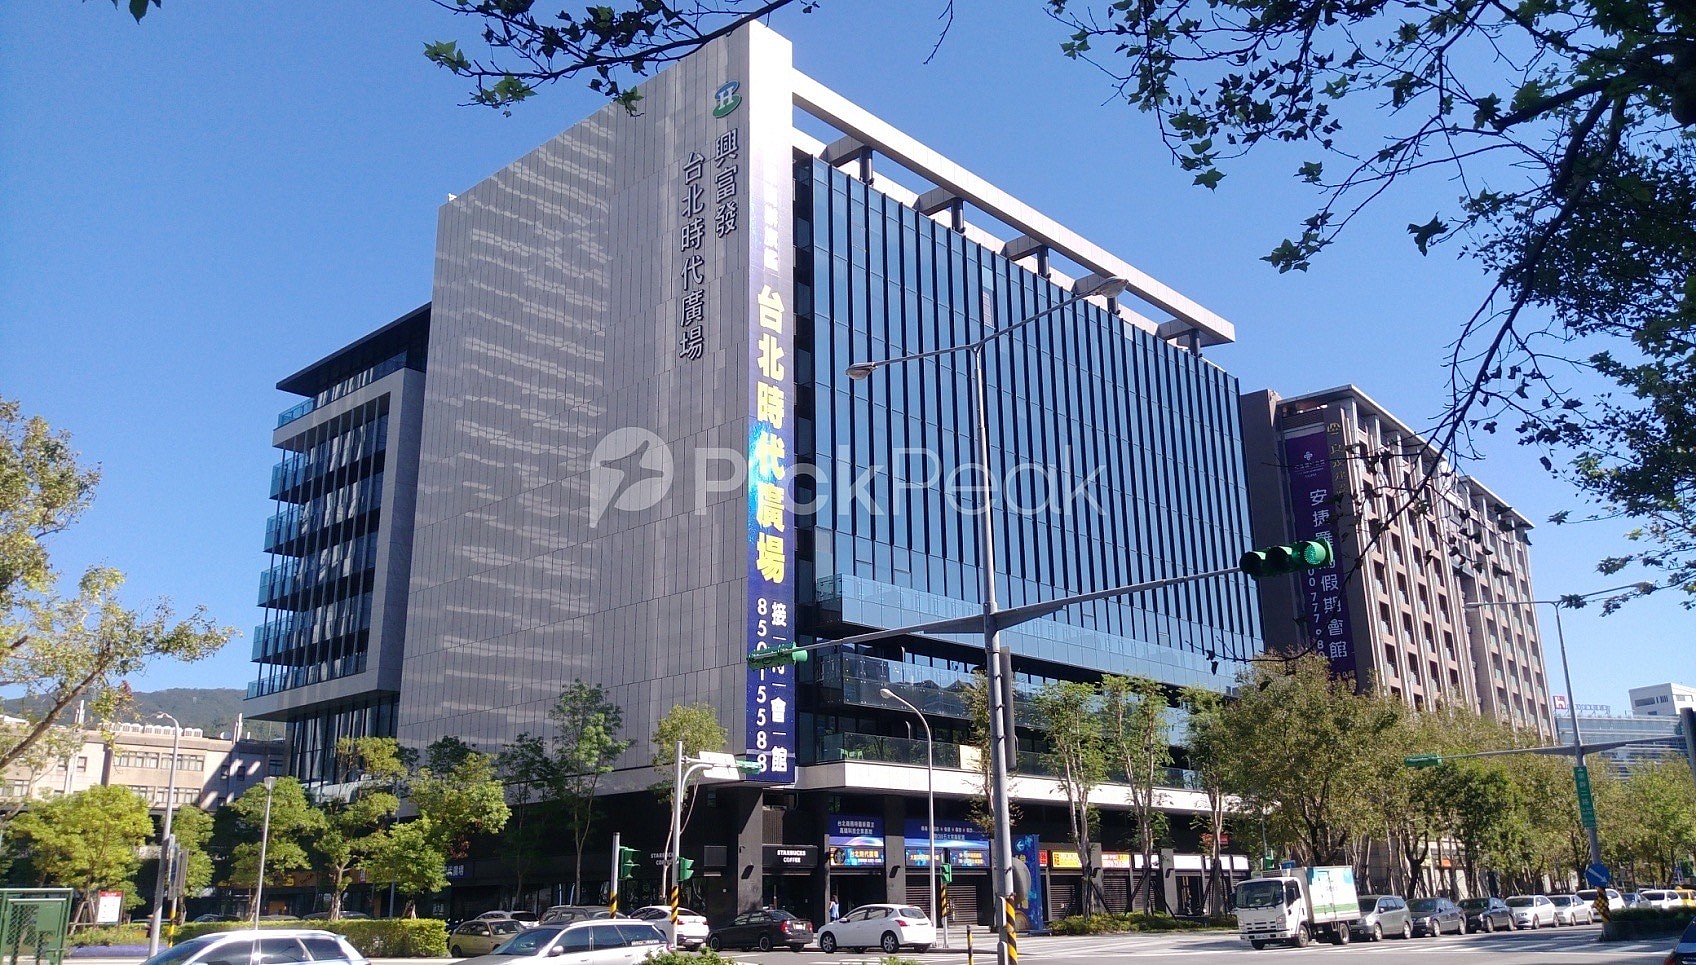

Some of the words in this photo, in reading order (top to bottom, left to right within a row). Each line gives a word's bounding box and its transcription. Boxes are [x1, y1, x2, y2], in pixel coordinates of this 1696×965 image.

[679, 151, 706, 362] 台北時代廣場
[714, 128, 739, 238] 興富發
[756, 284, 785, 585] 台北時代廣場
